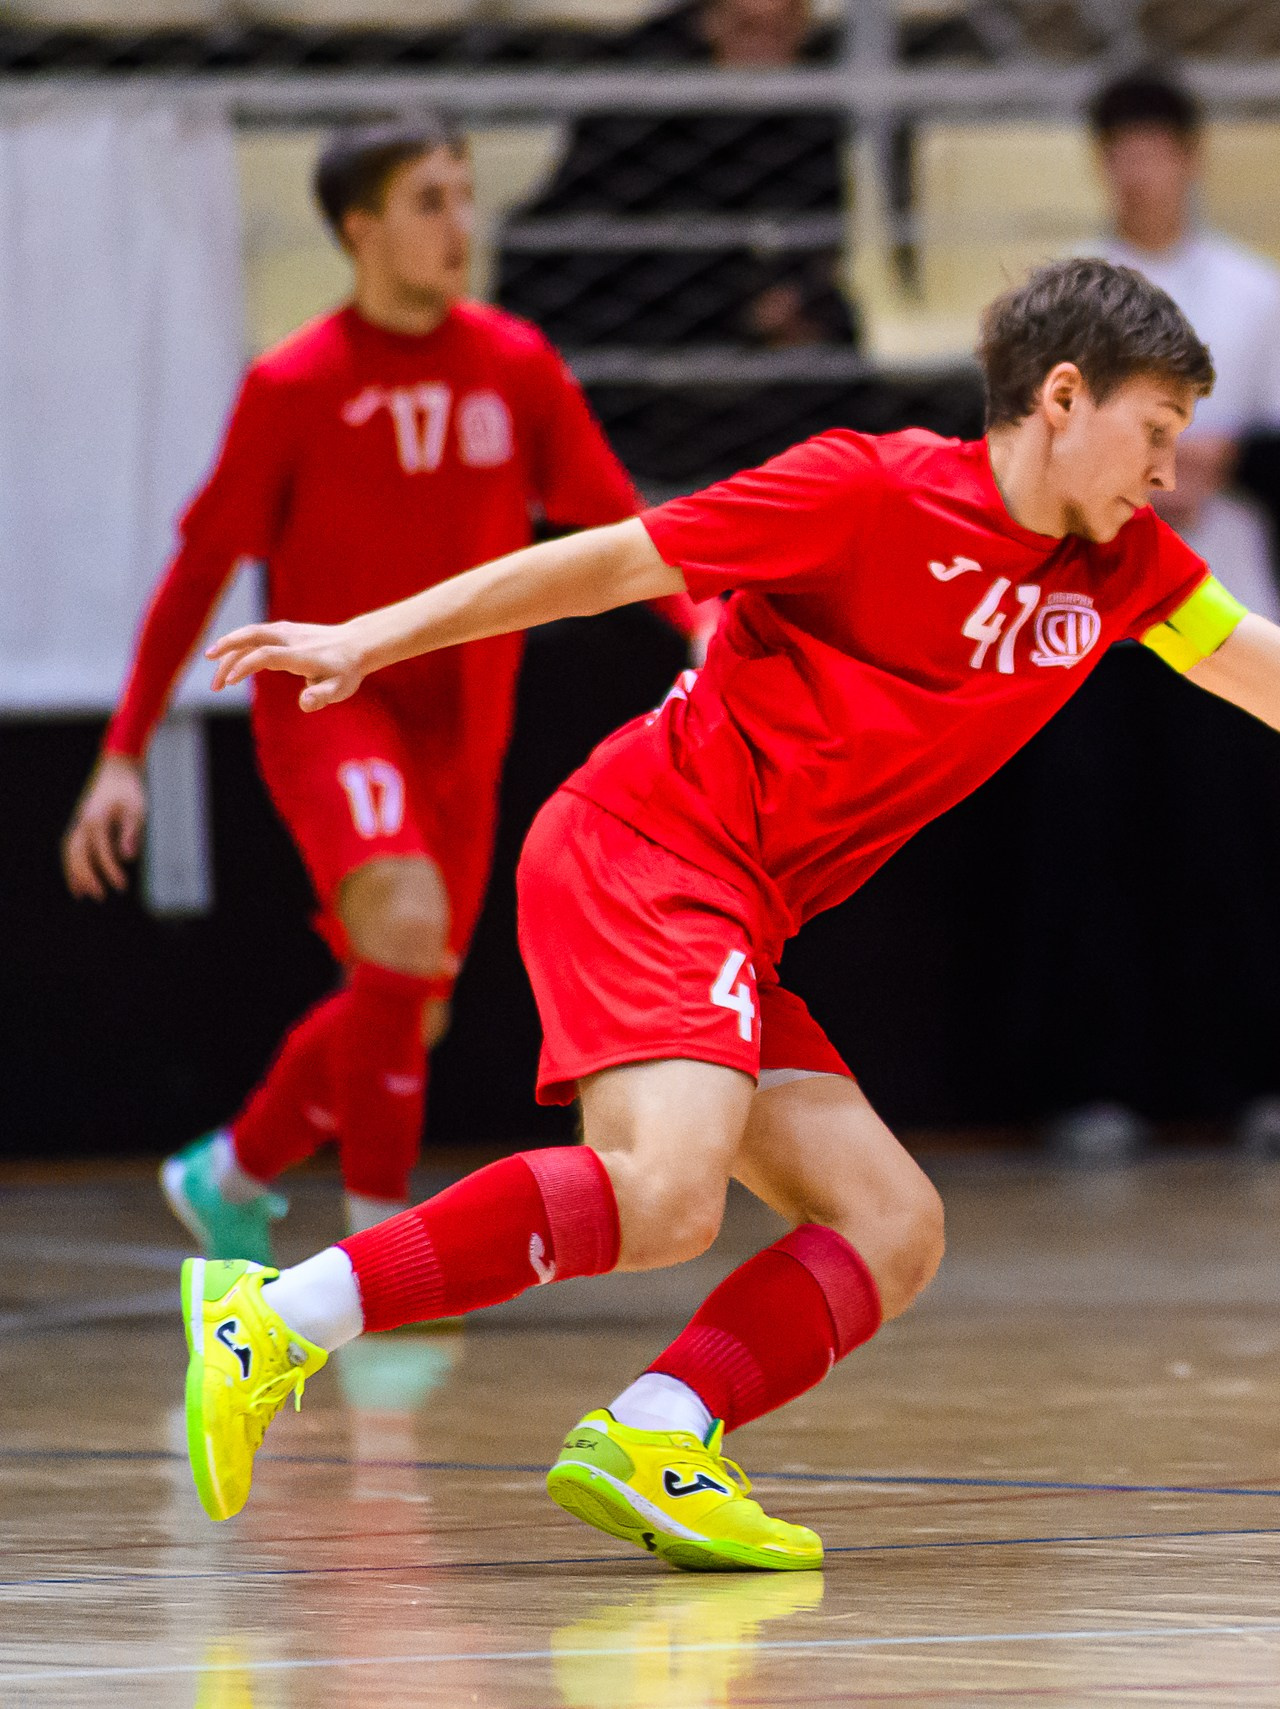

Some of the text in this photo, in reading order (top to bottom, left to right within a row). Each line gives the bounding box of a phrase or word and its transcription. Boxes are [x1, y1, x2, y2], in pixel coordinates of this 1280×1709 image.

[393, 381, 452, 475] 17
[961, 576, 1041, 675] 41
[338, 758, 405, 839] 17
[710, 949, 757, 1042] 4
